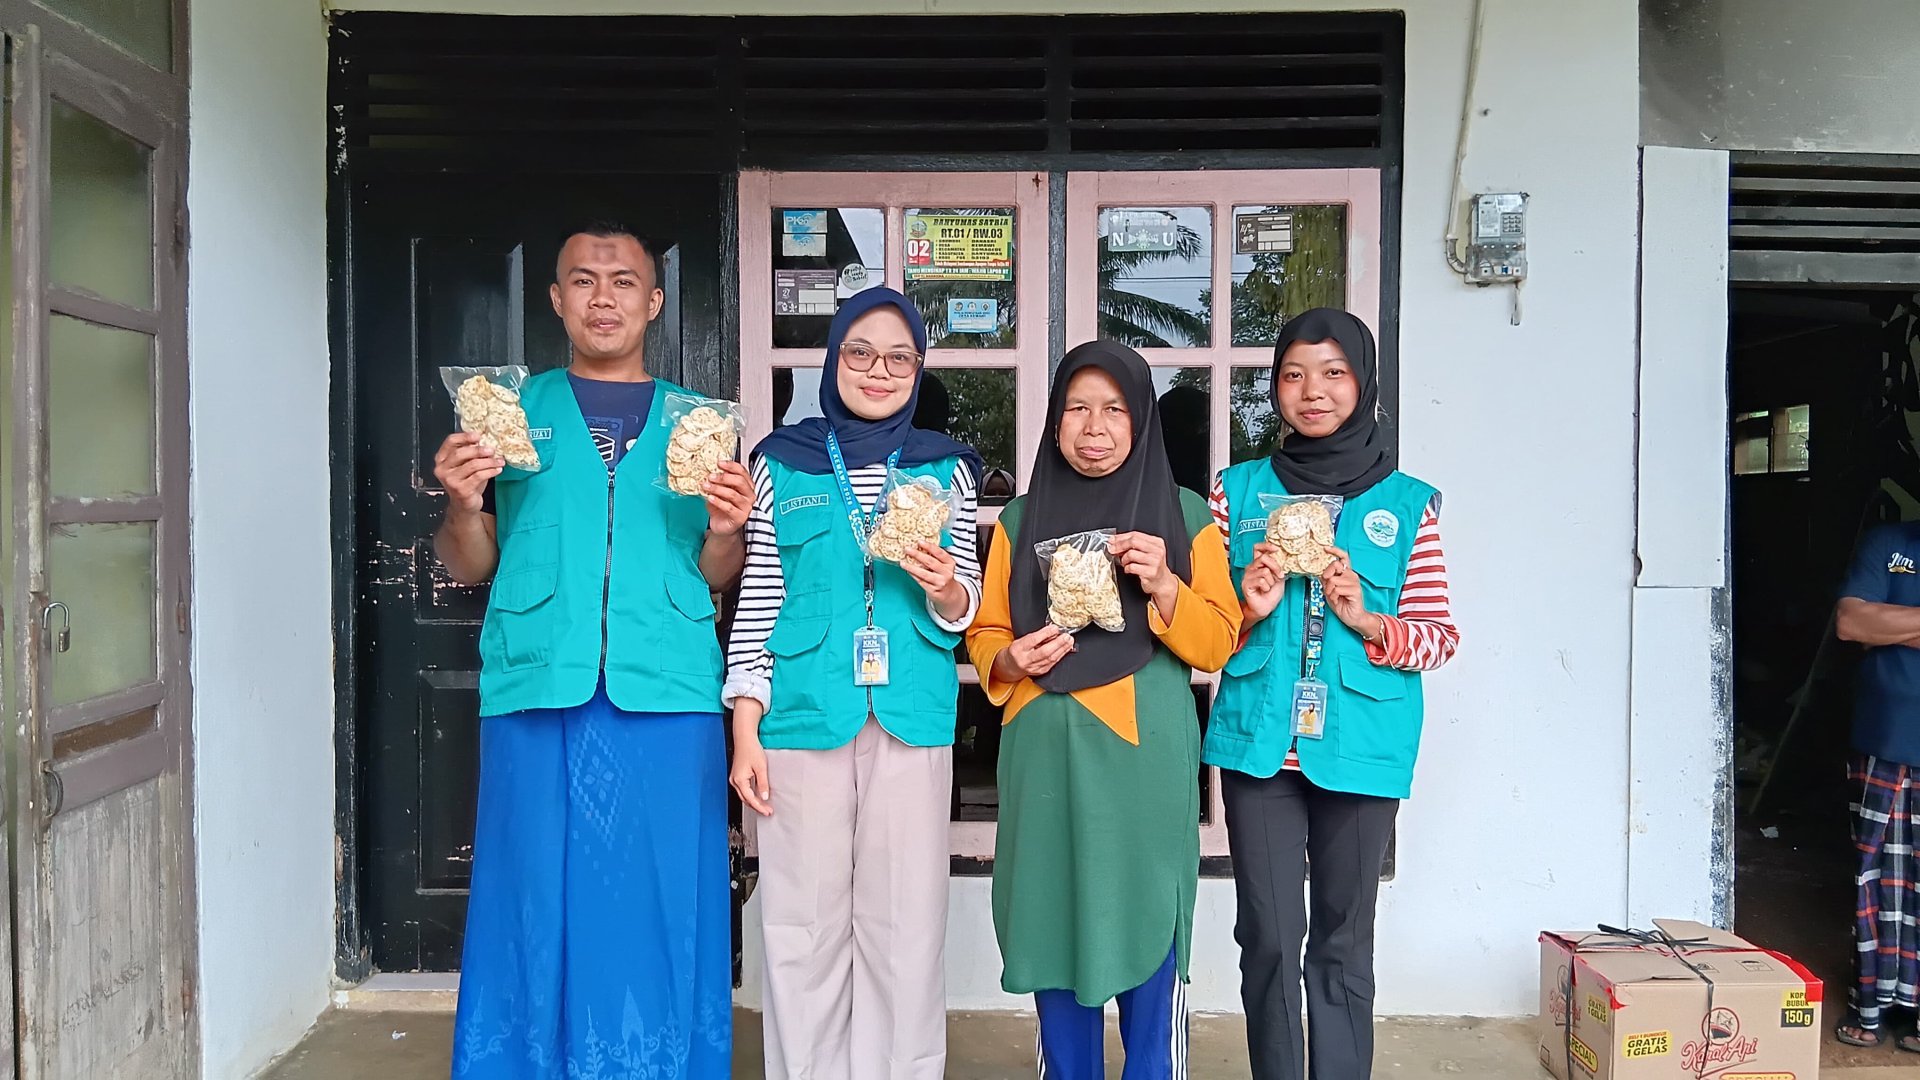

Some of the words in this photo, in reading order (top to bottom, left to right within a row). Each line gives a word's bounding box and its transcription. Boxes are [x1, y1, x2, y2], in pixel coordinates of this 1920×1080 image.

[933, 218, 977, 226] BANYUMAS
[978, 218, 1009, 226] SATRIA
[941, 228, 965, 239] RT.01
[973, 228, 1003, 239] RW.03
[1112, 232, 1124, 247] N
[1162, 232, 1174, 246] U
[907, 240, 930, 257] 02
[833, 454, 846, 485] KEMAWI
[1887, 552, 1914, 569] Jim
[1627, 1036, 1667, 1048] GRATIS
[1726, 1035, 1759, 1062] Api
[1569, 1035, 1593, 1066] PECIAL
[1626, 1048, 1631, 1057] 1
[1633, 1044, 1668, 1056] GELAS
